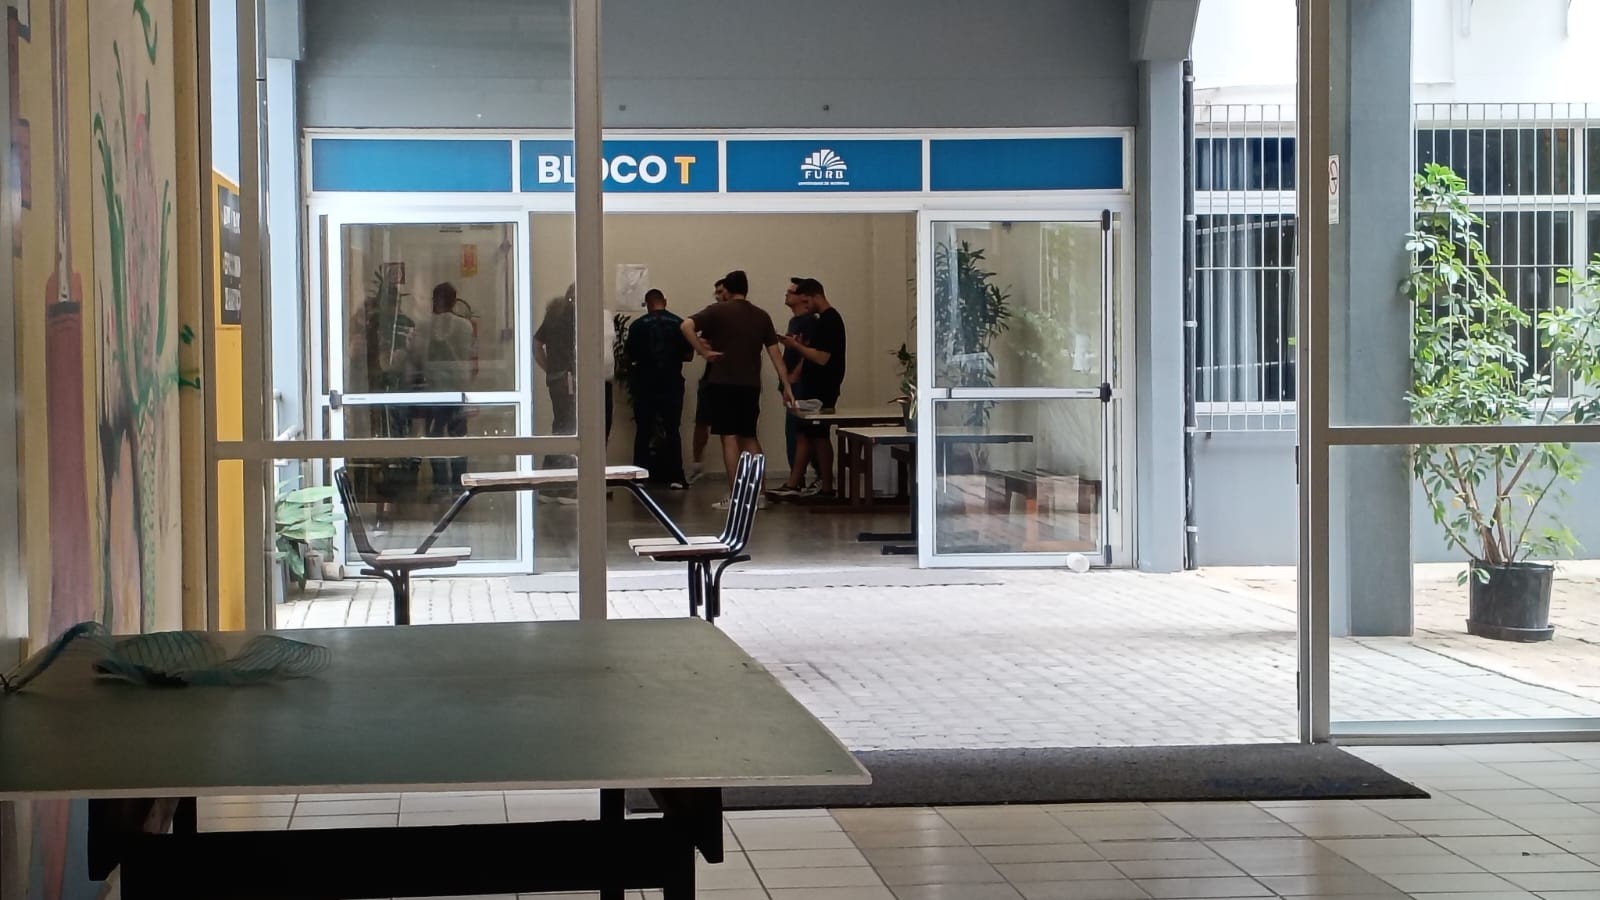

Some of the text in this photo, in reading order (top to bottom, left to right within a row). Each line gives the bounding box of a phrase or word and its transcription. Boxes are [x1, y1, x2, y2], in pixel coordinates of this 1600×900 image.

[538, 155, 696, 184] BLCO T
[805, 170, 843, 179] FURB
